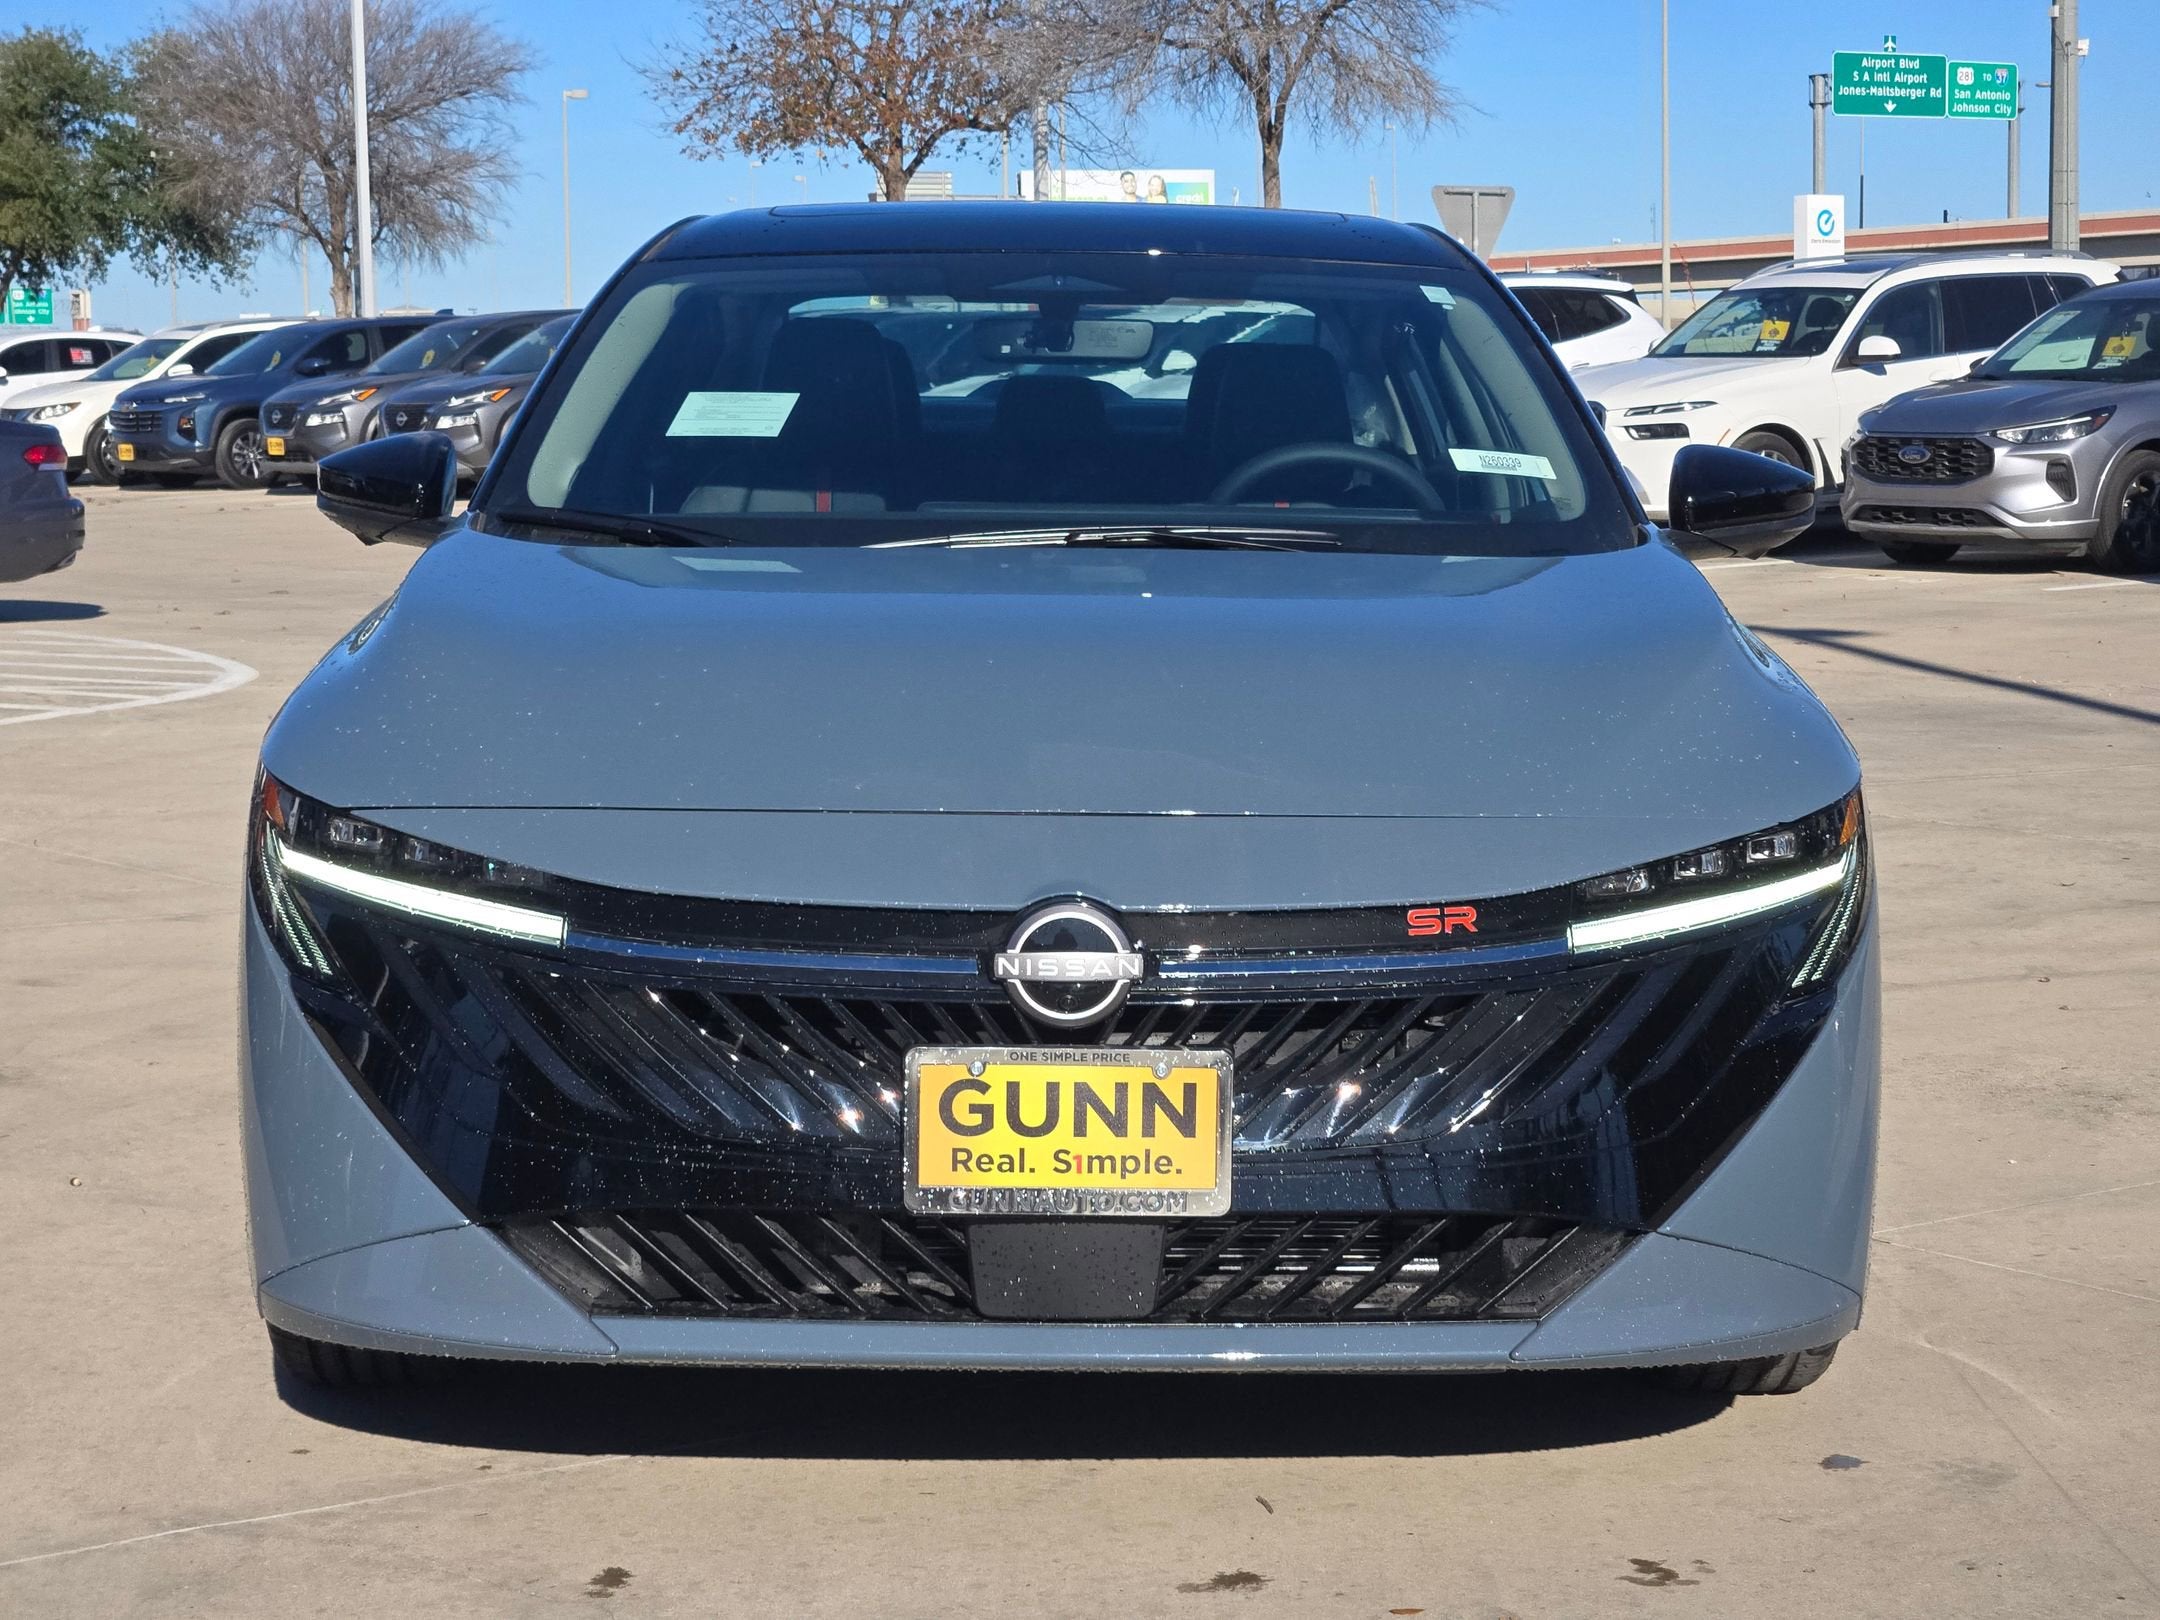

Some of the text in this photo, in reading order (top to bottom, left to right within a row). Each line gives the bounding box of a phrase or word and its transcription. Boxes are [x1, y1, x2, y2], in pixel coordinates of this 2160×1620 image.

[1861, 56, 1920, 70] Airport Blvd
[1853, 71, 1928, 85] S A Intl Airport
[1959, 71, 1973, 82] 281
[1983, 73, 1992, 81] TO
[1838, 84, 1942, 99] Jones-Maltsberger Rd
[1954, 89, 2011, 101] San Antonio
[1952, 102, 2012, 115] Johnson City
[1407, 906, 1479, 936] SR
[998, 957, 1140, 976] NISSAN
[1010, 1051, 1130, 1063] ONE SIMPLE PRICE
[939, 1079, 1197, 1138] GUNN
[952, 1148, 1036, 1174] Real.
[949, 1189, 1188, 1213] GUNNAUTO.COM
